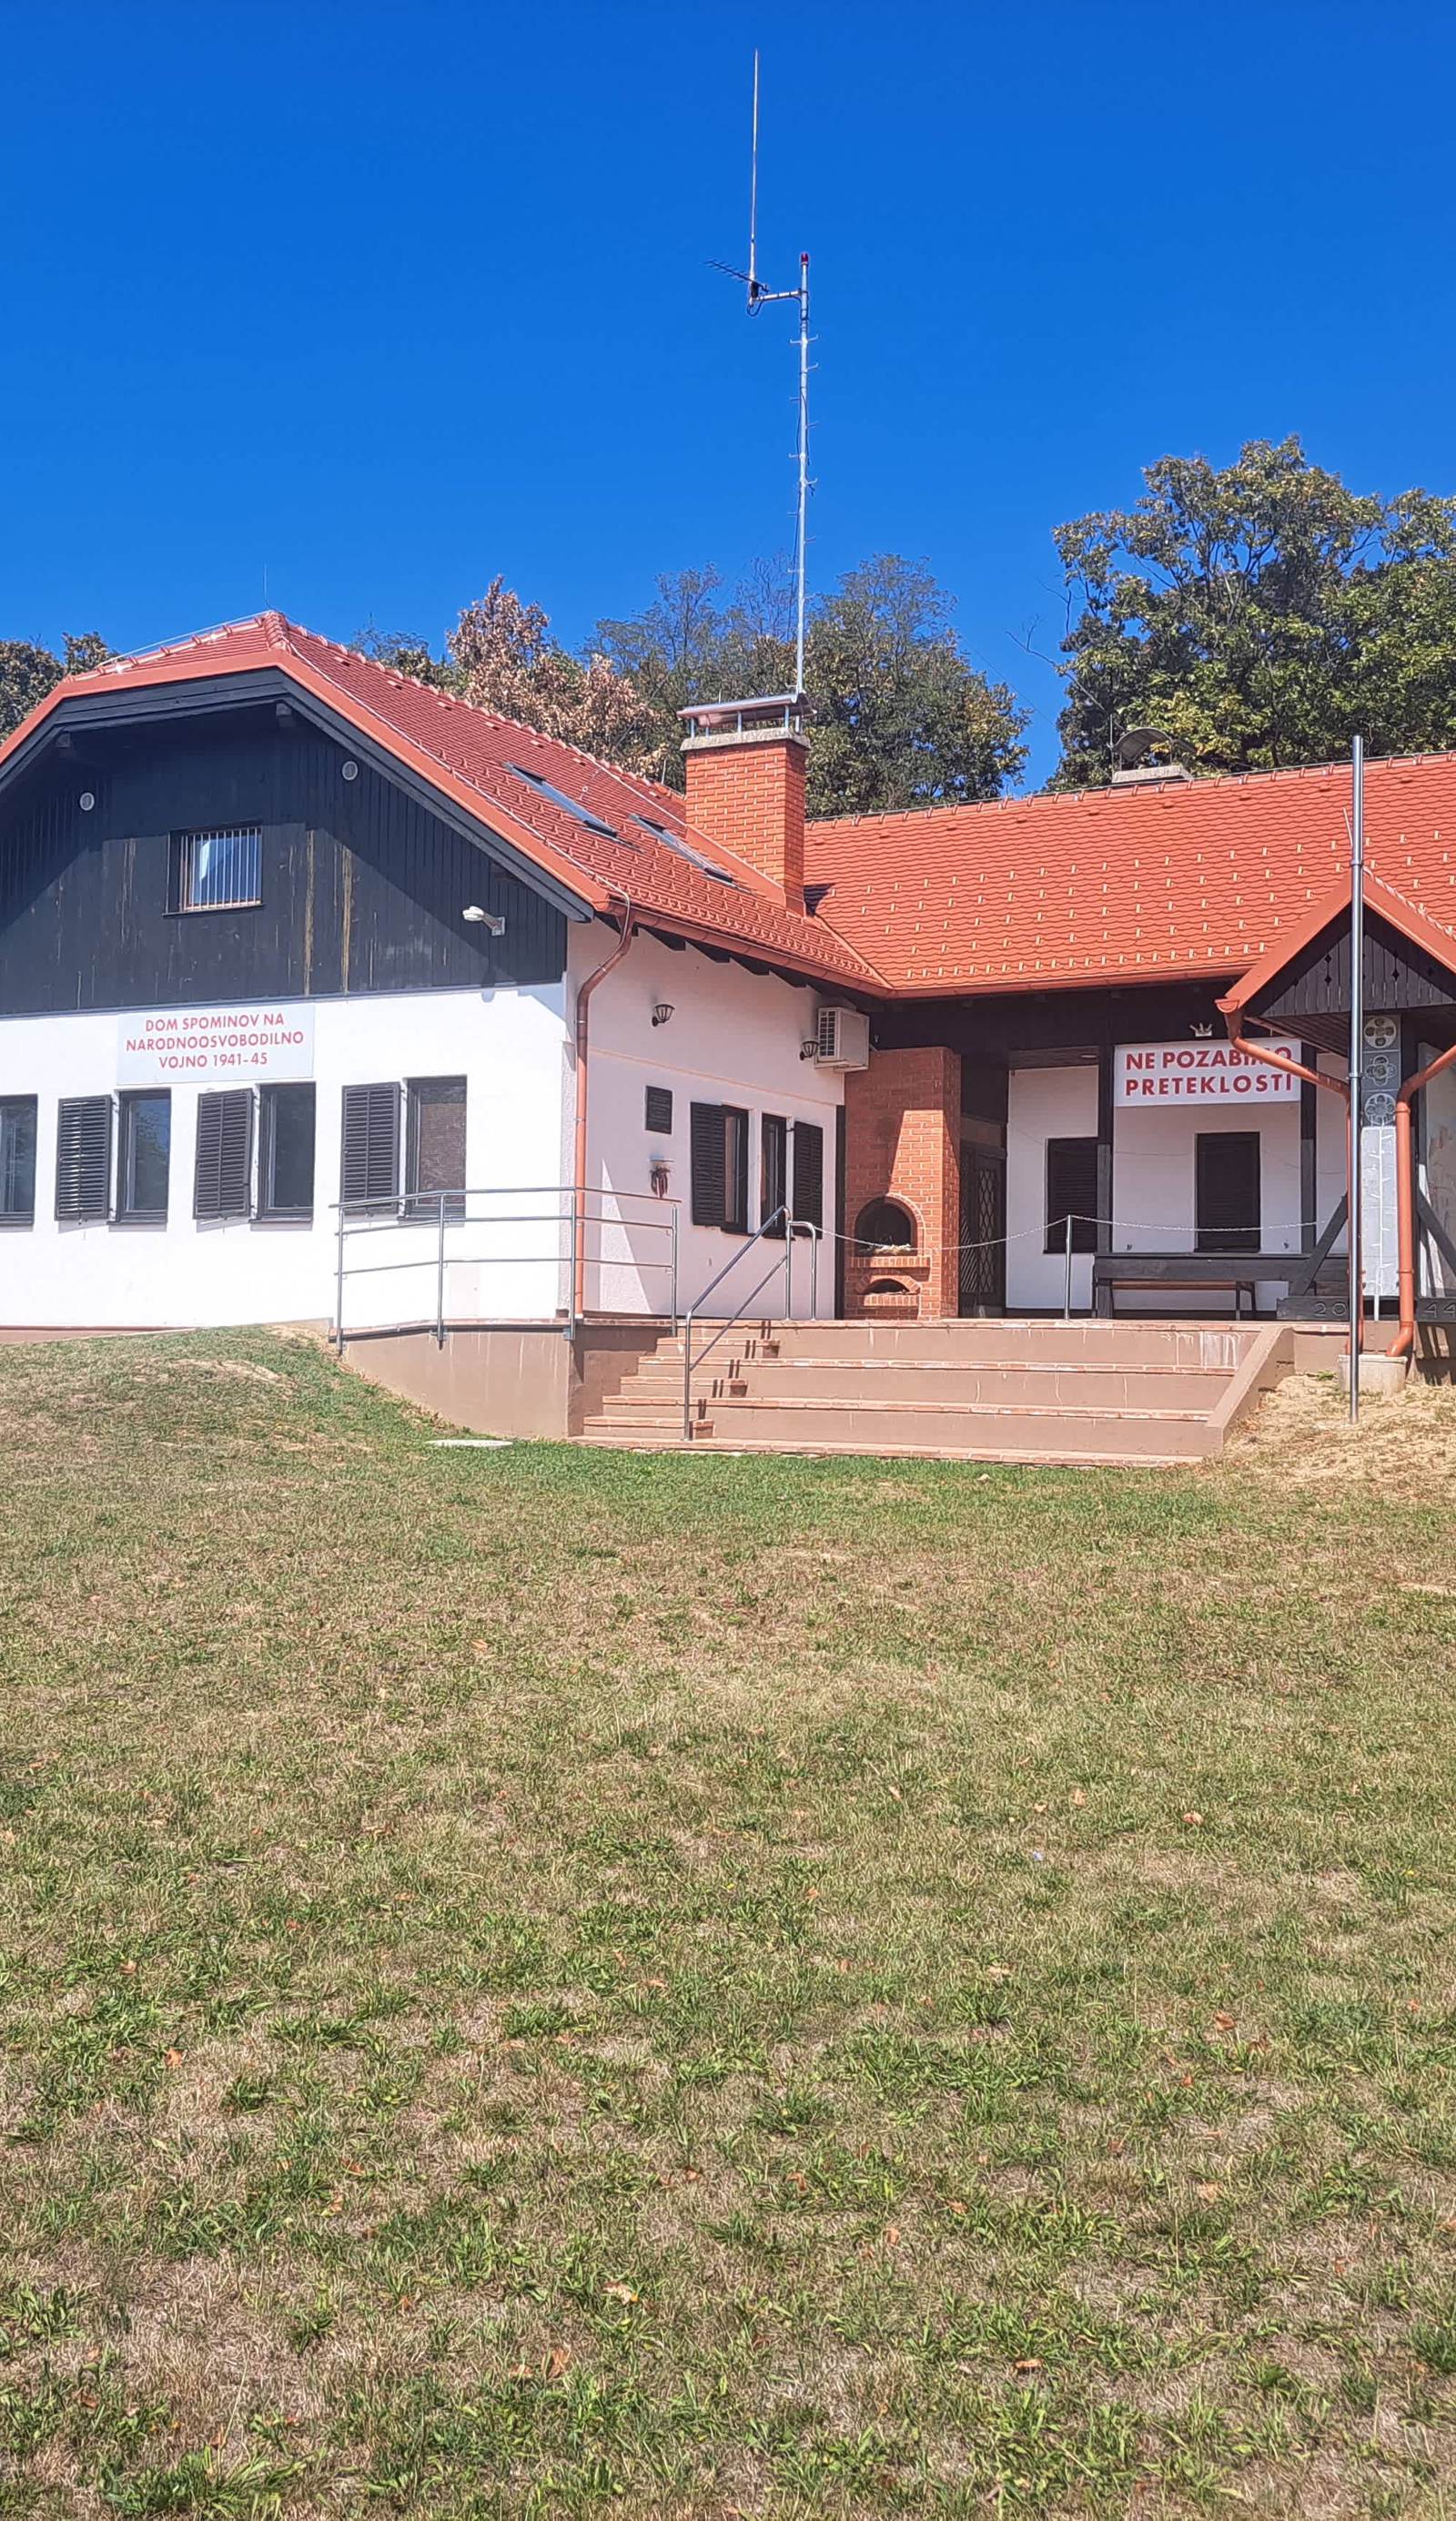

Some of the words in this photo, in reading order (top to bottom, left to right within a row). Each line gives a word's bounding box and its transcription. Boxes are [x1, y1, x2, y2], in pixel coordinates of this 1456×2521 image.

[146, 1018, 178, 1032] DOM
[182, 1014, 259, 1030] SPOMINOV
[263, 1013, 284, 1026] NA
[126, 1031, 304, 1052] NARODNOOSVOBODILNO
[158, 1055, 207, 1068] VOJNO
[213, 1052, 268, 1067] 1941-45
[1126, 1052, 1155, 1070] NE
[1126, 1073, 1292, 1096] PRETEKLOSTI
